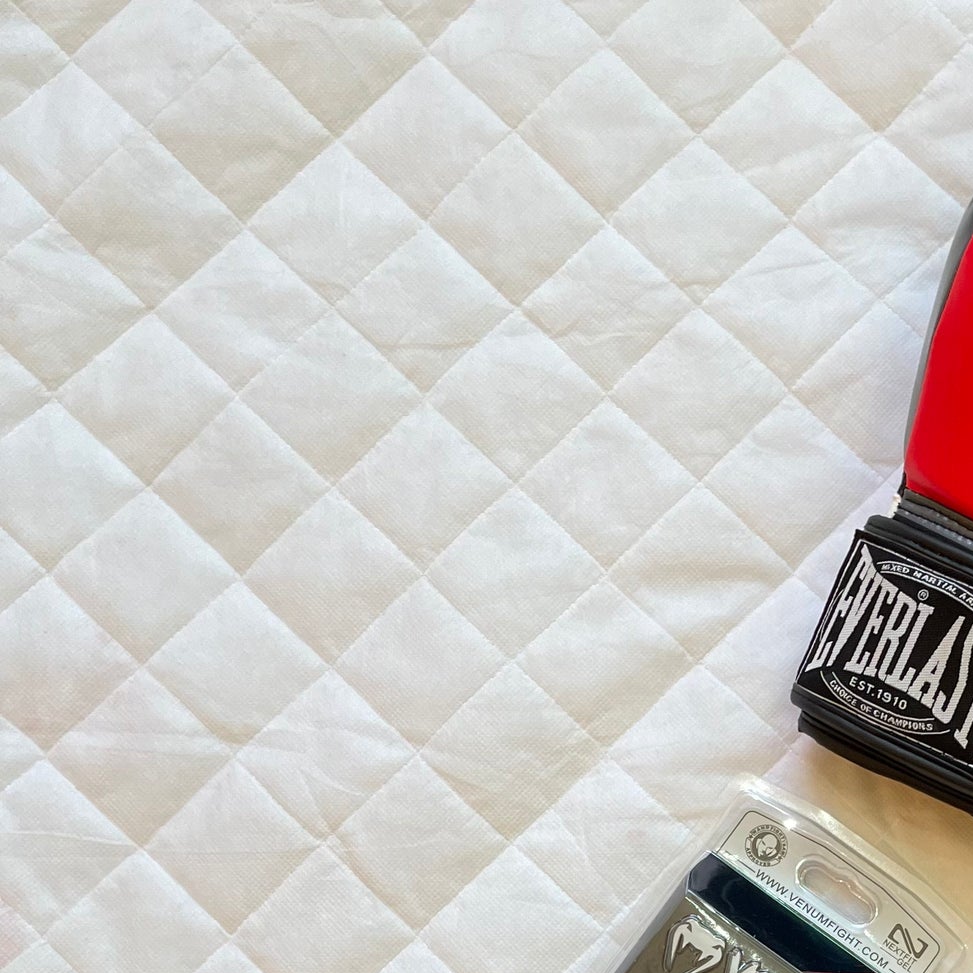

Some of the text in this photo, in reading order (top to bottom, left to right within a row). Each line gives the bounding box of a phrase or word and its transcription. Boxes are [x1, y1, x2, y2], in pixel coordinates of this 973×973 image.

[881, 563, 910, 574] MIXED
[912, 570, 958, 595] MARTIAL
[829, 679, 934, 731] CHOICE OF CHAMPIONS
[755, 868, 889, 969] WWW.VENUMFIGHT.COM
[882, 938, 918, 966] NEXTFIT
[896, 957, 913, 973] GEL
